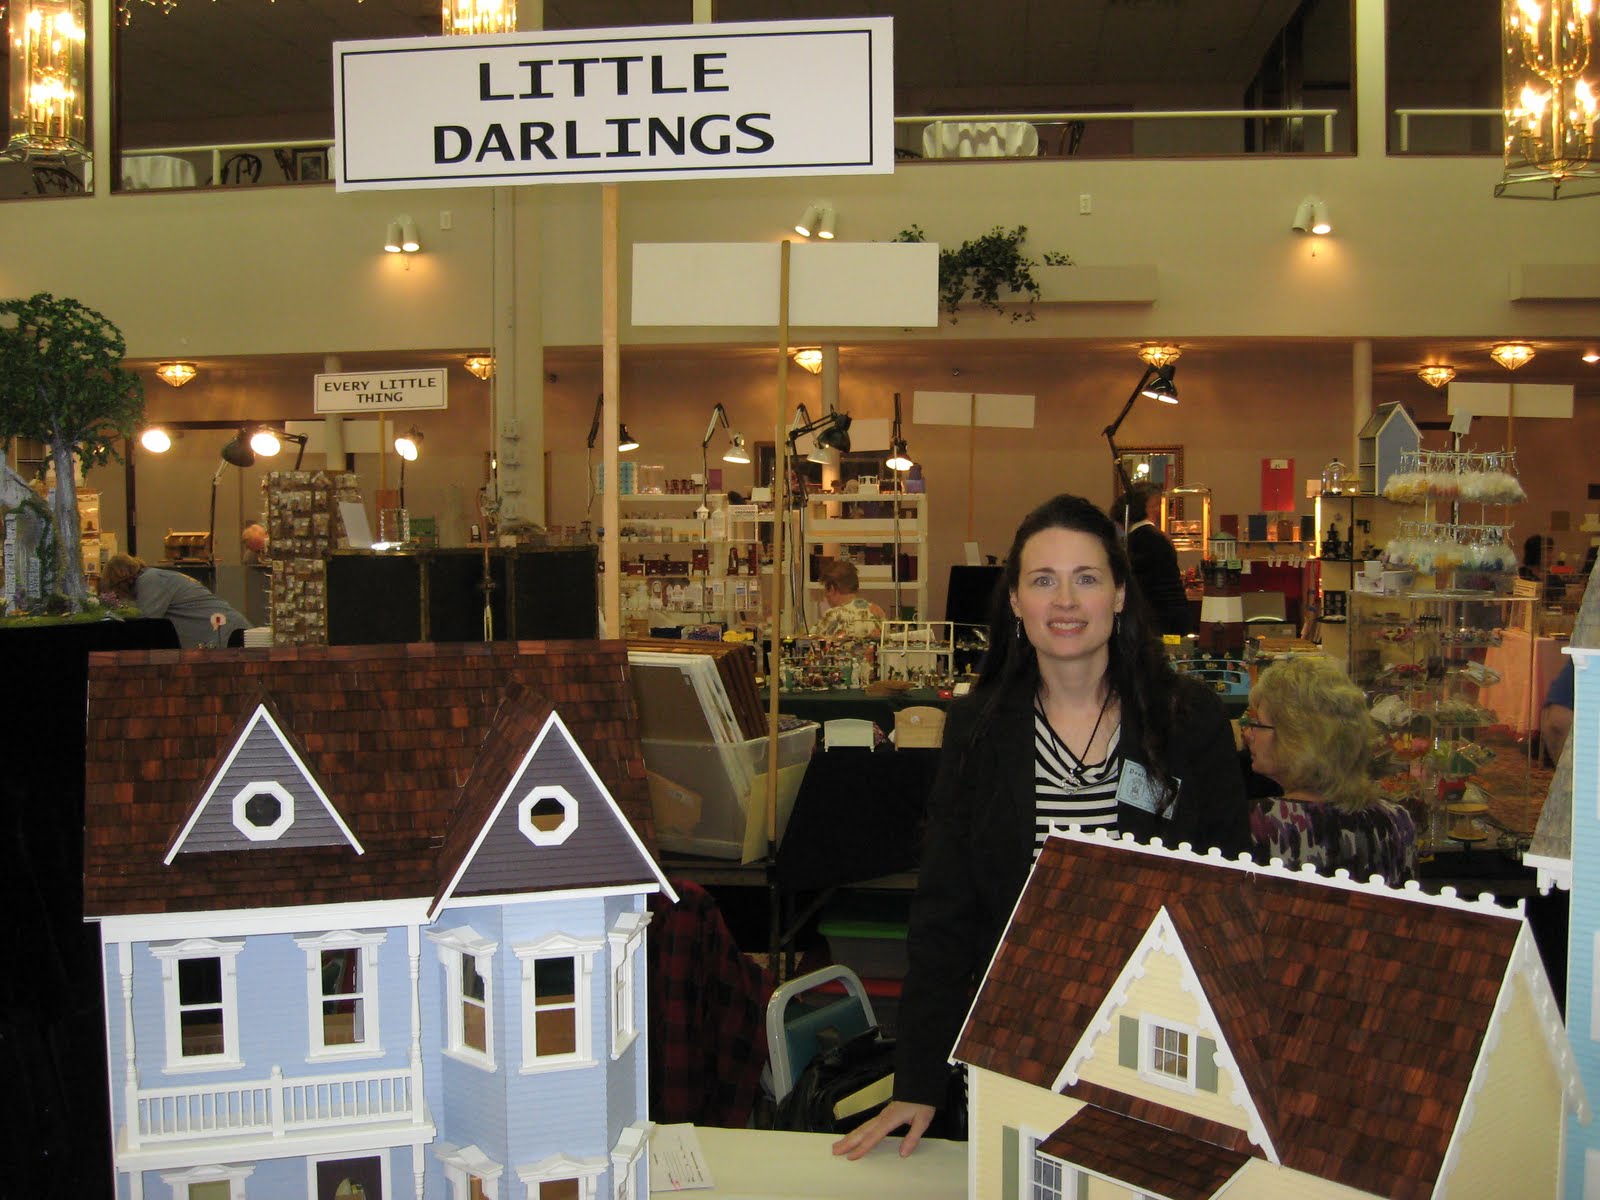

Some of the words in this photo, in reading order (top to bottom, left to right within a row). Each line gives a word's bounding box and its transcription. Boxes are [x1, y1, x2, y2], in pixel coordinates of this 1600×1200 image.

[479, 52, 729, 101] LITTLE
[434, 113, 774, 164] DARLINGS
[324, 381, 370, 392] EVERY
[380, 378, 436, 389] LITTLE
[356, 392, 403, 403] THING
[1129, 768, 1146, 778] Deal
